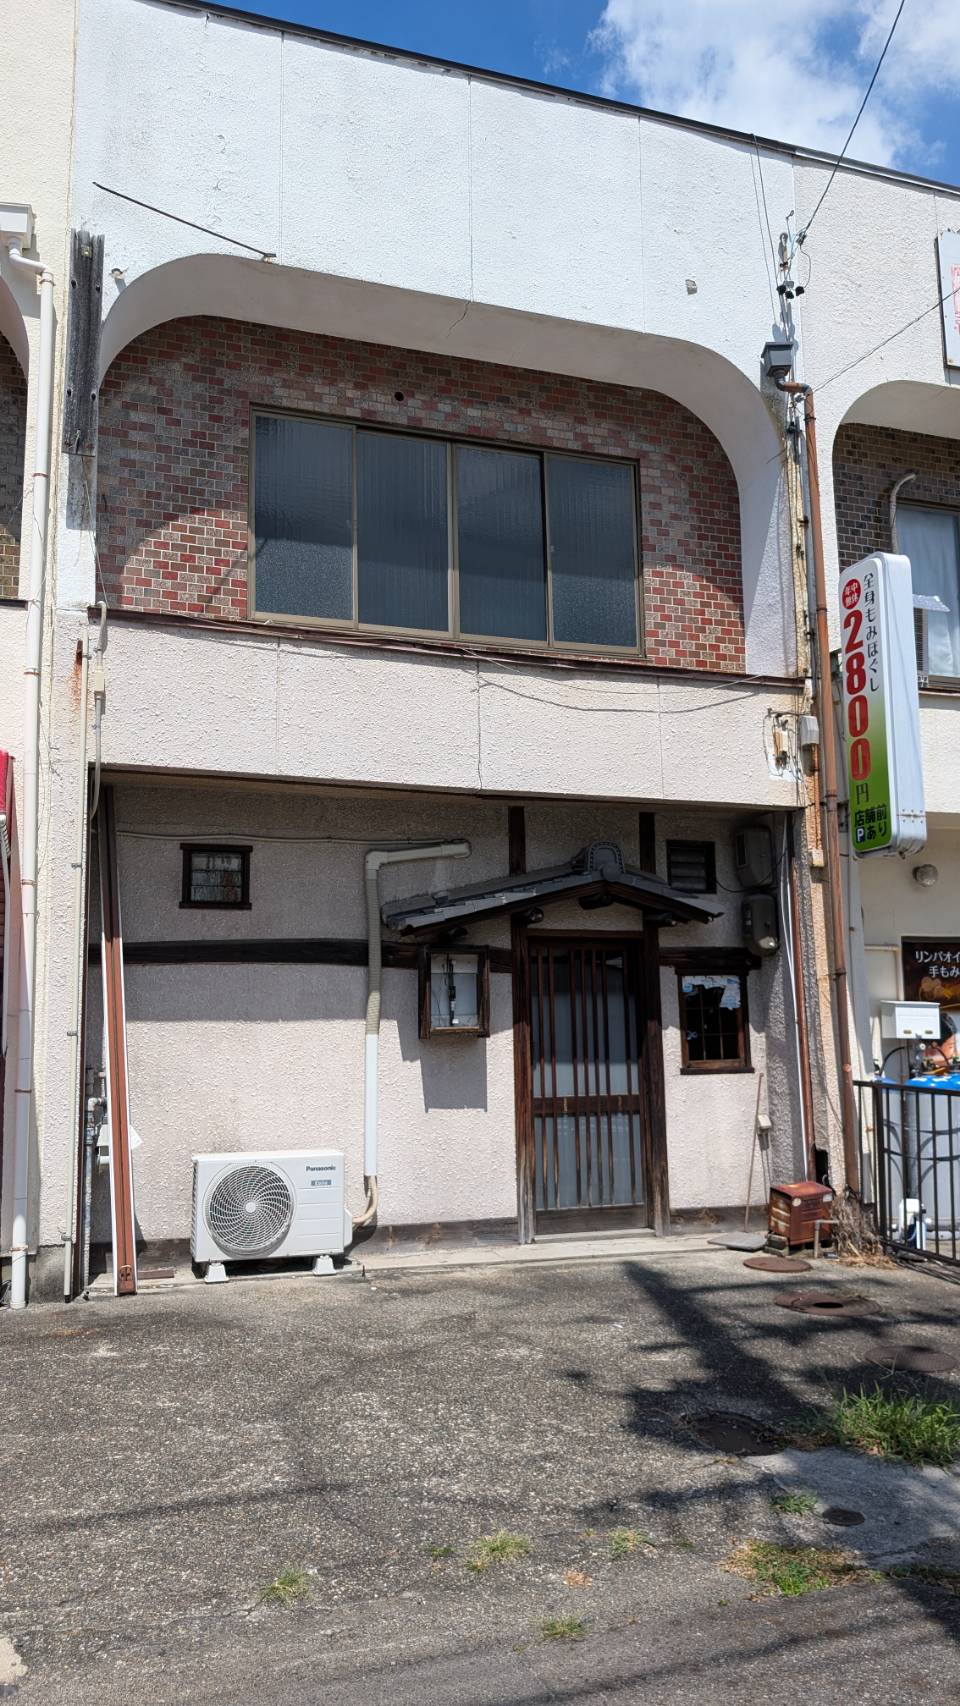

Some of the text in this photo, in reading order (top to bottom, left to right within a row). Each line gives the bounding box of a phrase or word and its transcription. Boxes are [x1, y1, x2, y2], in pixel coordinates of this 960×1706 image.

[863, 572, 879, 692] 全身もみほぐし
[854, 805, 887, 828] 店舗前
[306, 1164, 337, 1172] Panasonic
